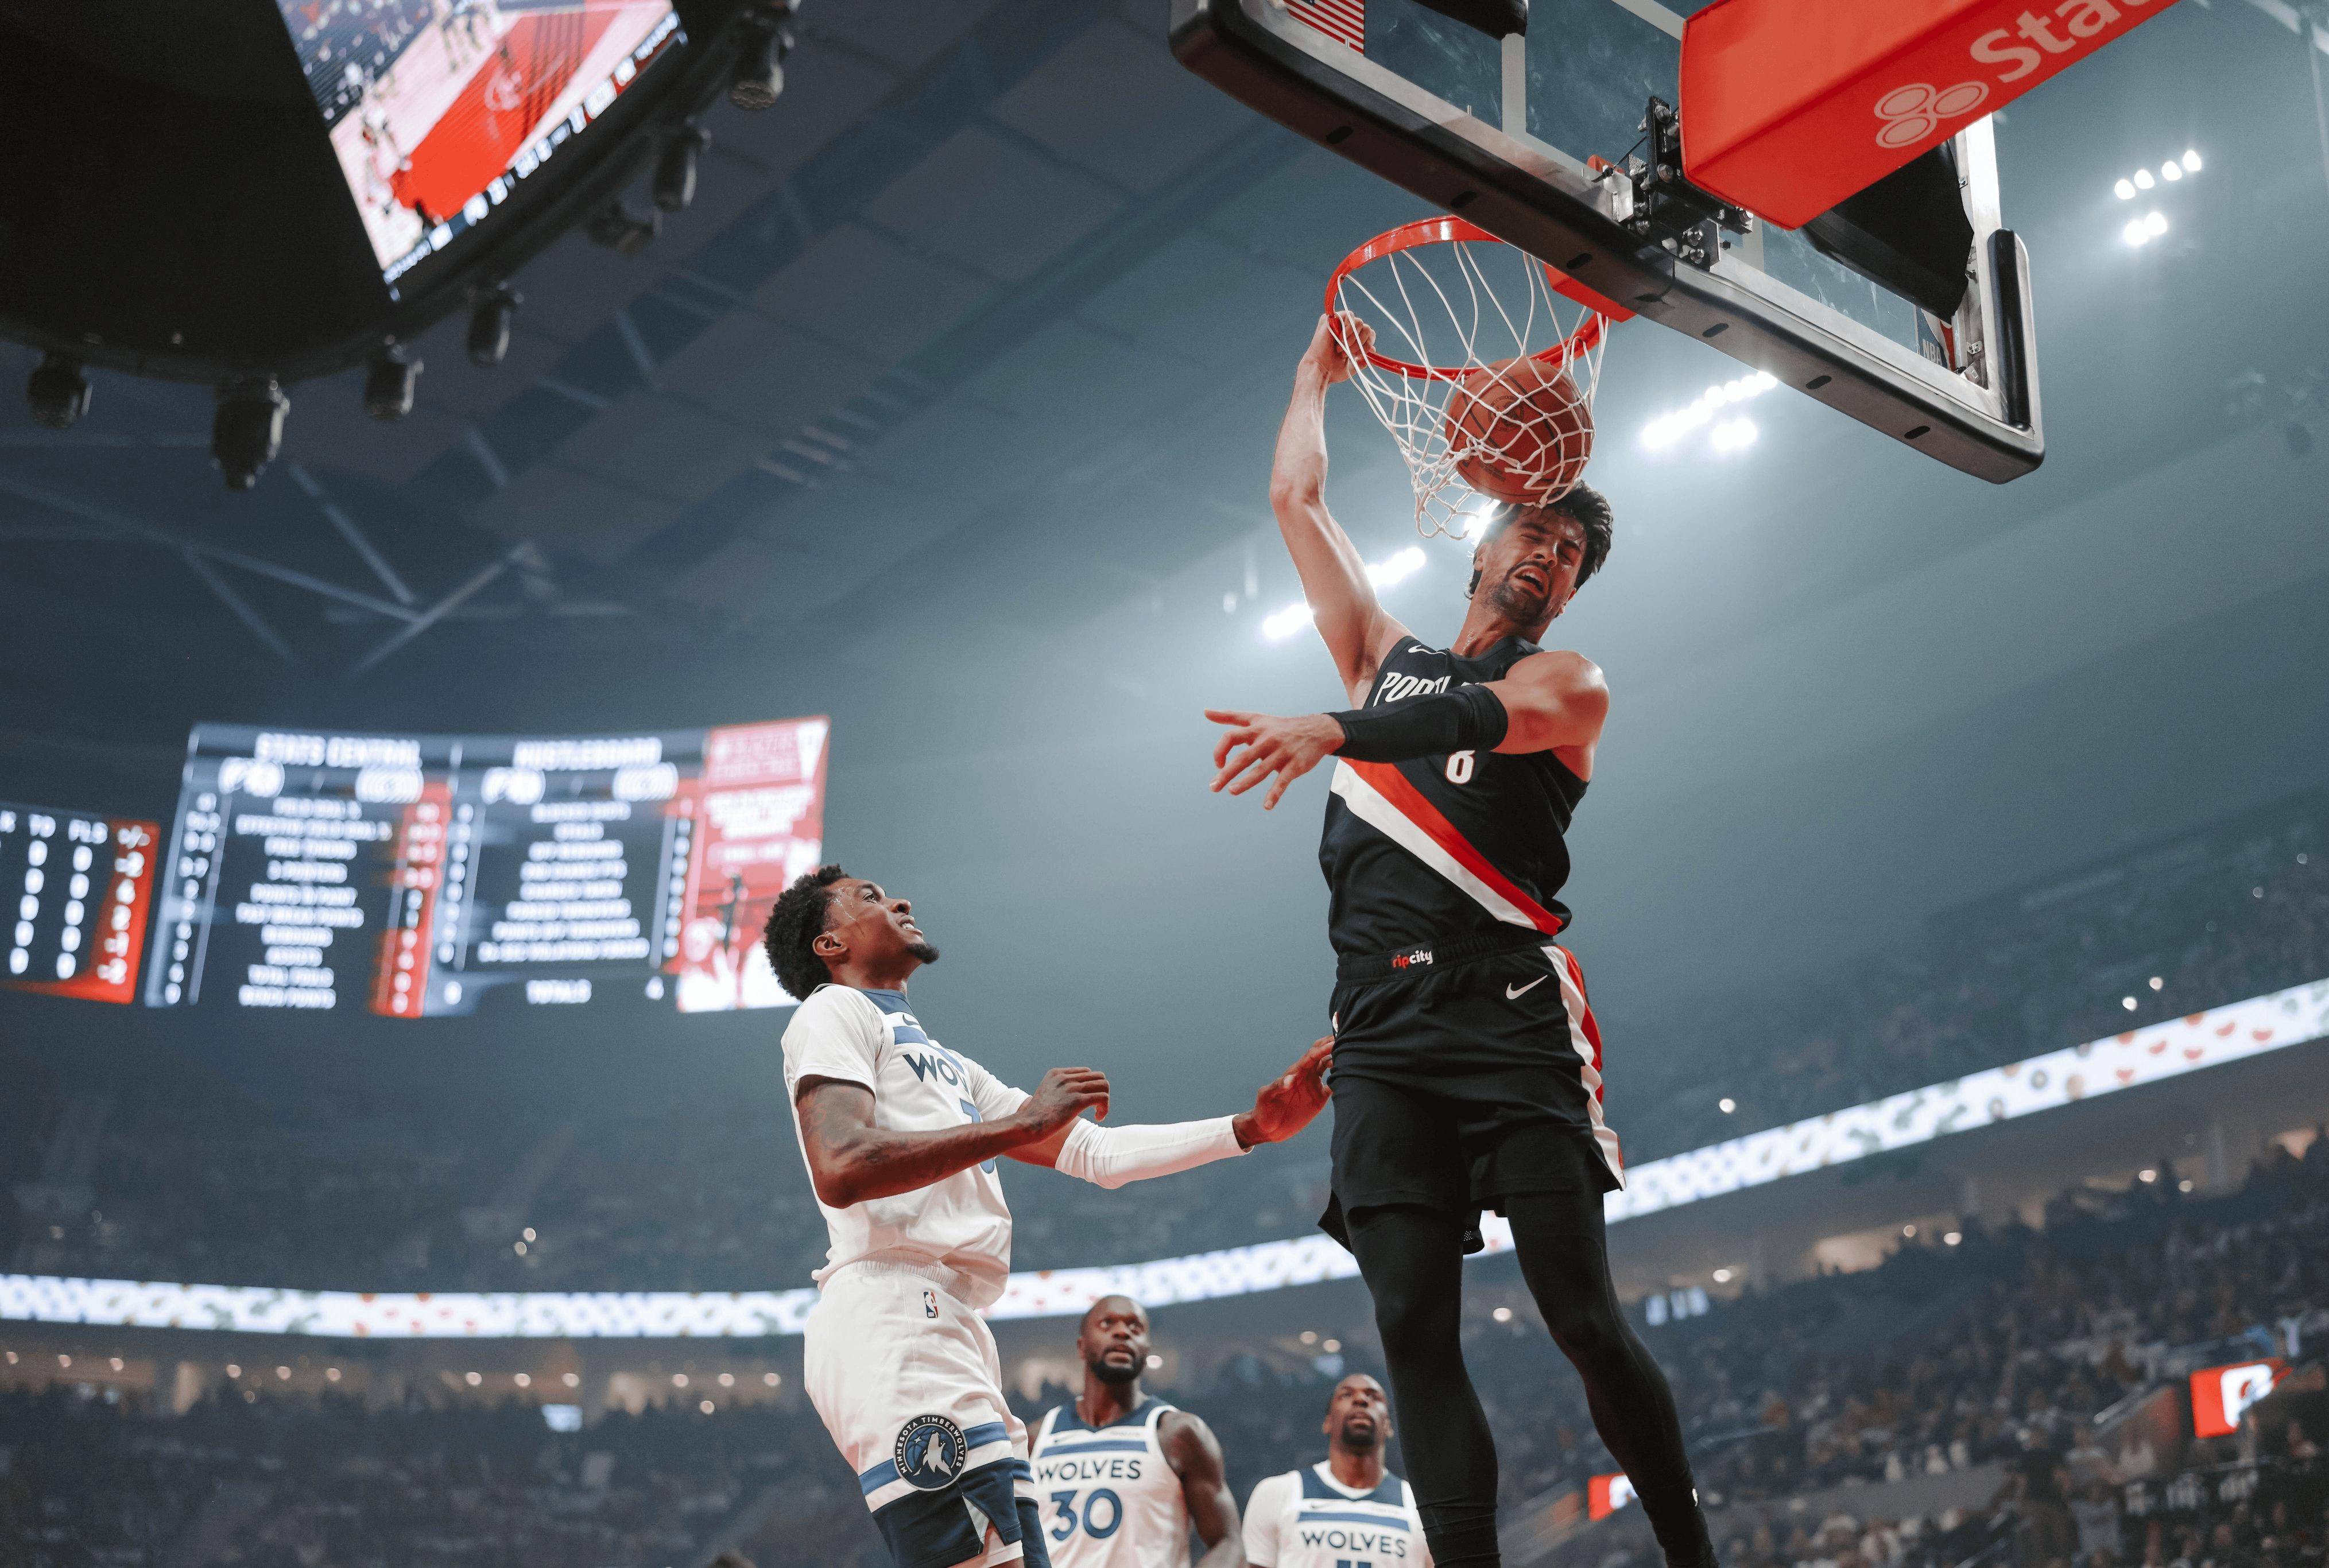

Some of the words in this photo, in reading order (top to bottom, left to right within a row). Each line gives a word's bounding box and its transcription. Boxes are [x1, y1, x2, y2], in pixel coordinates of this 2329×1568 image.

[1922, 339, 1943, 367] NBA
[1373, 672, 1480, 708] PORTL
[1393, 950, 1433, 969] ripcity
[897, 1422, 918, 1474] MINNESOTA
[921, 1416, 964, 1467] TIMBERWOLVES
[1037, 1459, 1141, 1482] WOLVES
[1051, 1488, 1122, 1541] 30
[1301, 1531, 1405, 1557] WOLVES
